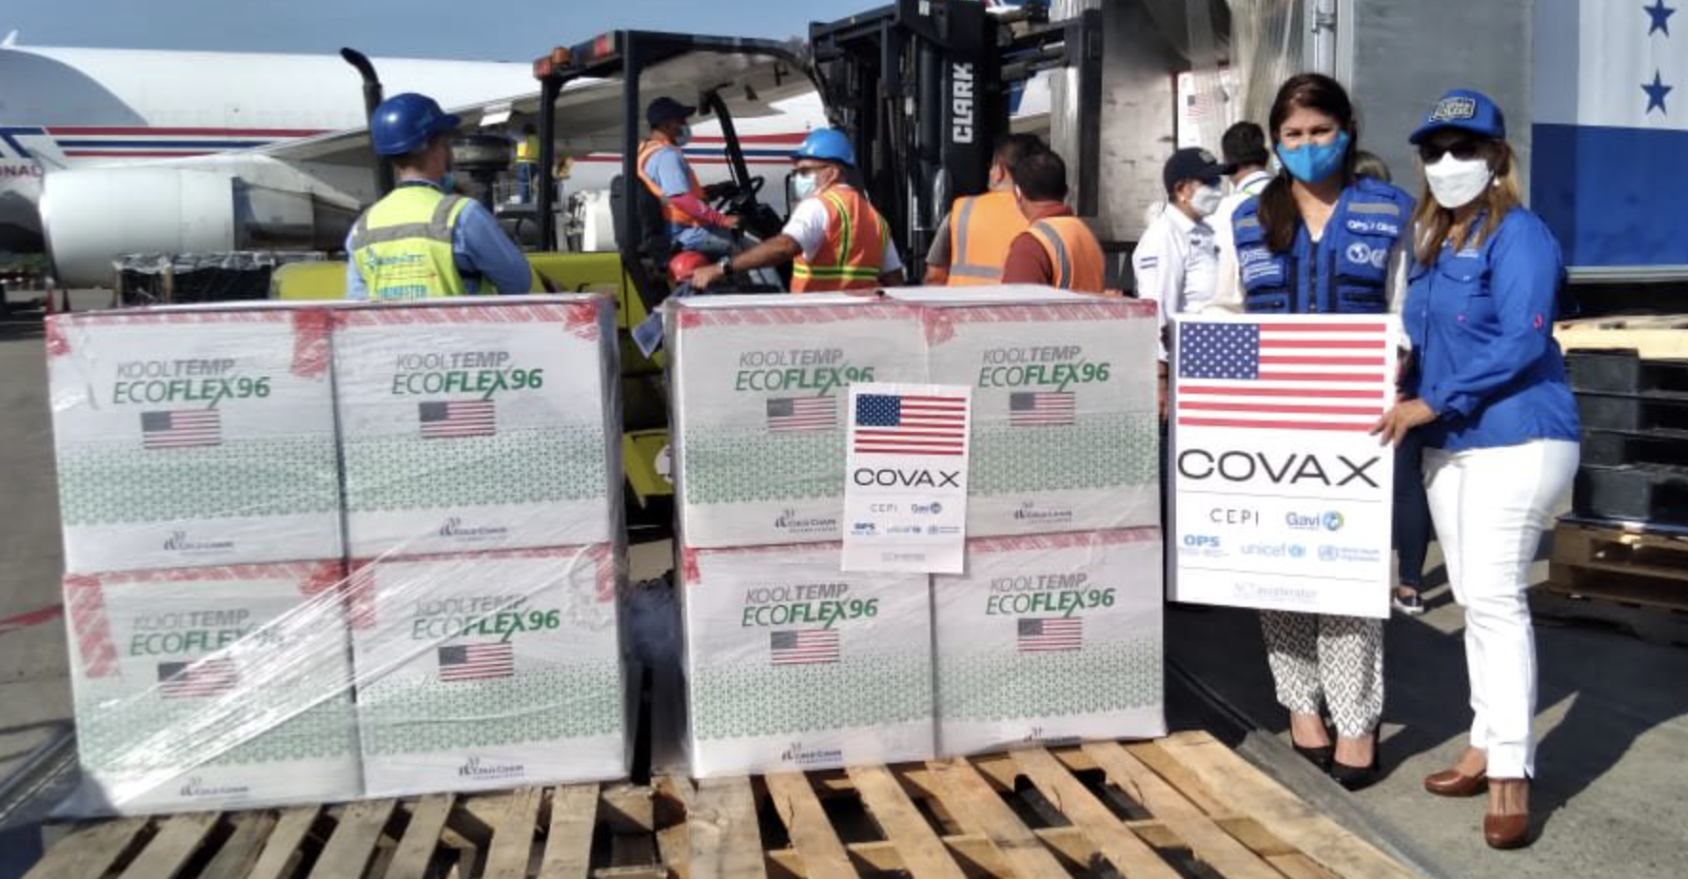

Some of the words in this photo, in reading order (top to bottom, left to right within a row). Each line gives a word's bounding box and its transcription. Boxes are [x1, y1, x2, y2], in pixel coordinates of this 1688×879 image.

[952, 62, 974, 144] CLARK
[396, 351, 511, 371] KOOLTEMP
[739, 349, 844, 367] KOOLTEMP
[982, 345, 1083, 365] KOOLTEMP
[116, 358, 236, 379] KOOLTEMP
[978, 362, 1111, 391] ECOFLEX96
[391, 368, 545, 399] ECOFLEX96
[734, 366, 875, 394] ECOFLEX96
[112, 375, 271, 408] ECOFLEX96
[853, 467, 961, 489] COVAX
[1177, 448, 1382, 489] COVAX
[1209, 507, 1260, 527] CEPI
[1285, 511, 1321, 527] Gavi
[1183, 534, 1221, 548] OPS
[1240, 543, 1287, 558] unicef
[745, 583, 849, 604] KOOLTEMP
[990, 572, 1088, 593] KOOLTEMP
[985, 588, 1116, 617] ECOFLEX96
[133, 608, 251, 632] KOOLTEMP
[411, 609, 560, 641] ECOFLEX96
[741, 599, 880, 629] ECOFLEX96
